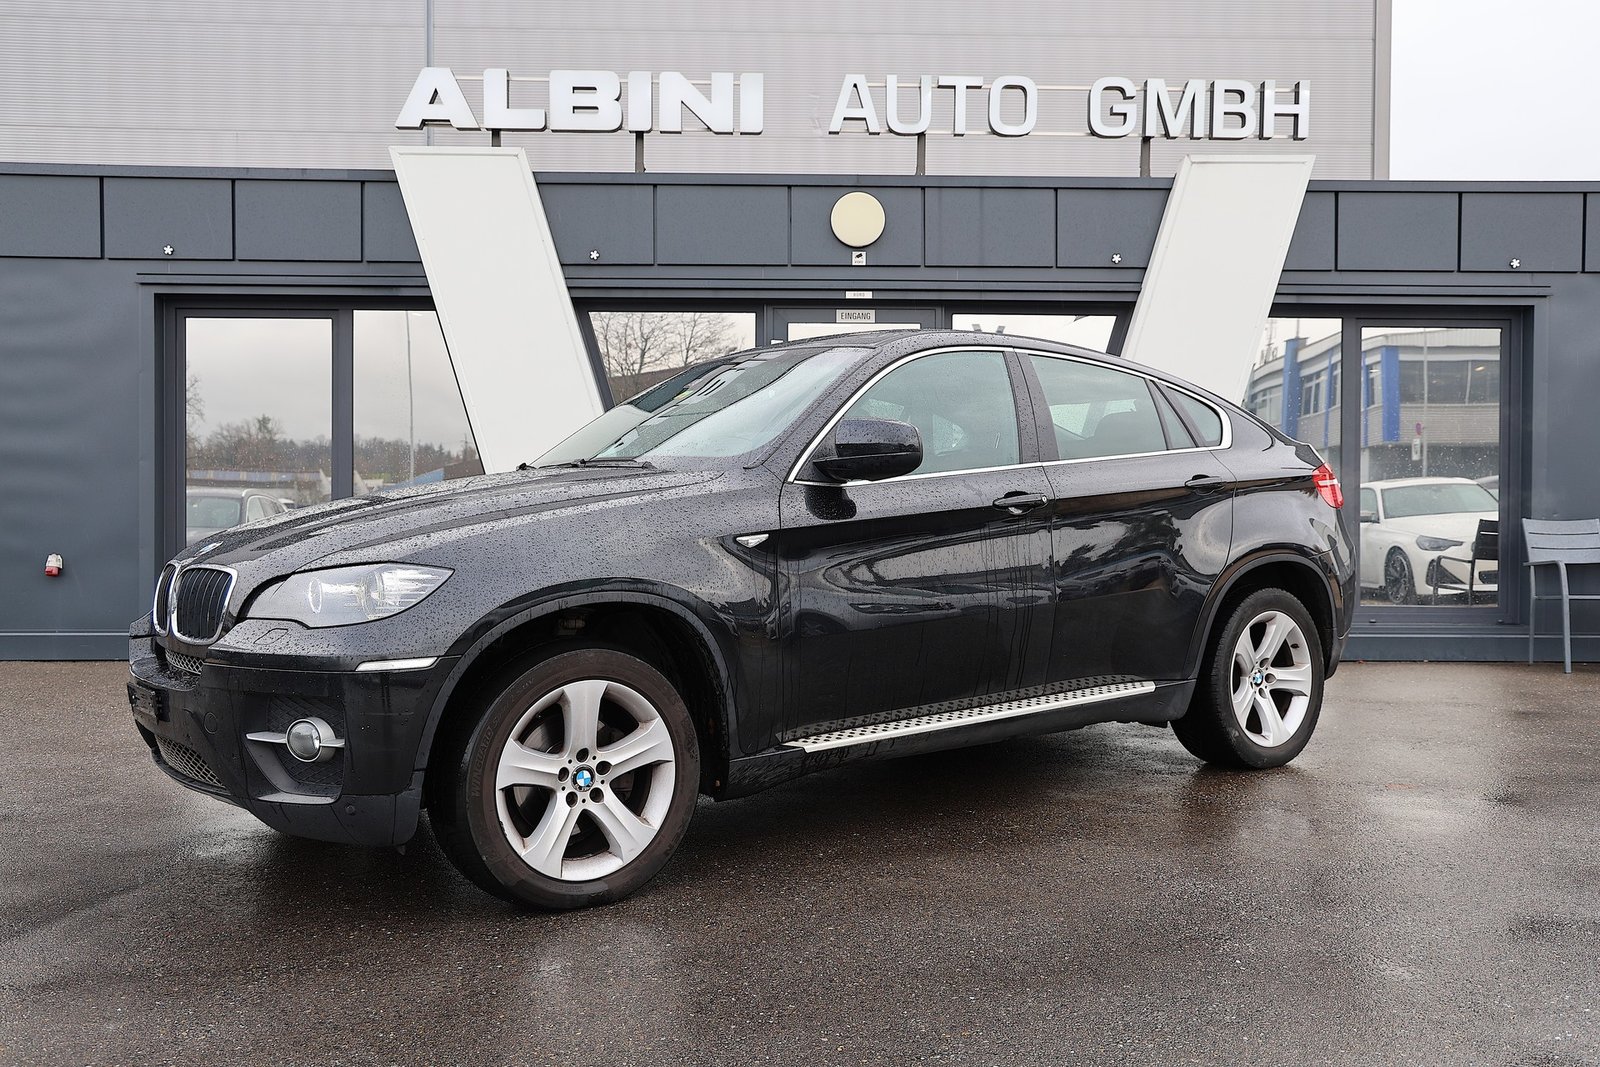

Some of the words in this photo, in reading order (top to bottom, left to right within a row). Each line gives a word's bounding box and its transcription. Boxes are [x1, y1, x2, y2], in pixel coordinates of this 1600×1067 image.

[395, 67, 764, 135] ALBINI
[829, 73, 1038, 137] AUTO
[1088, 76, 1310, 140] GMBH
[841, 312, 871, 320] EINGANG
[471, 728, 493, 797] WINGUARD
